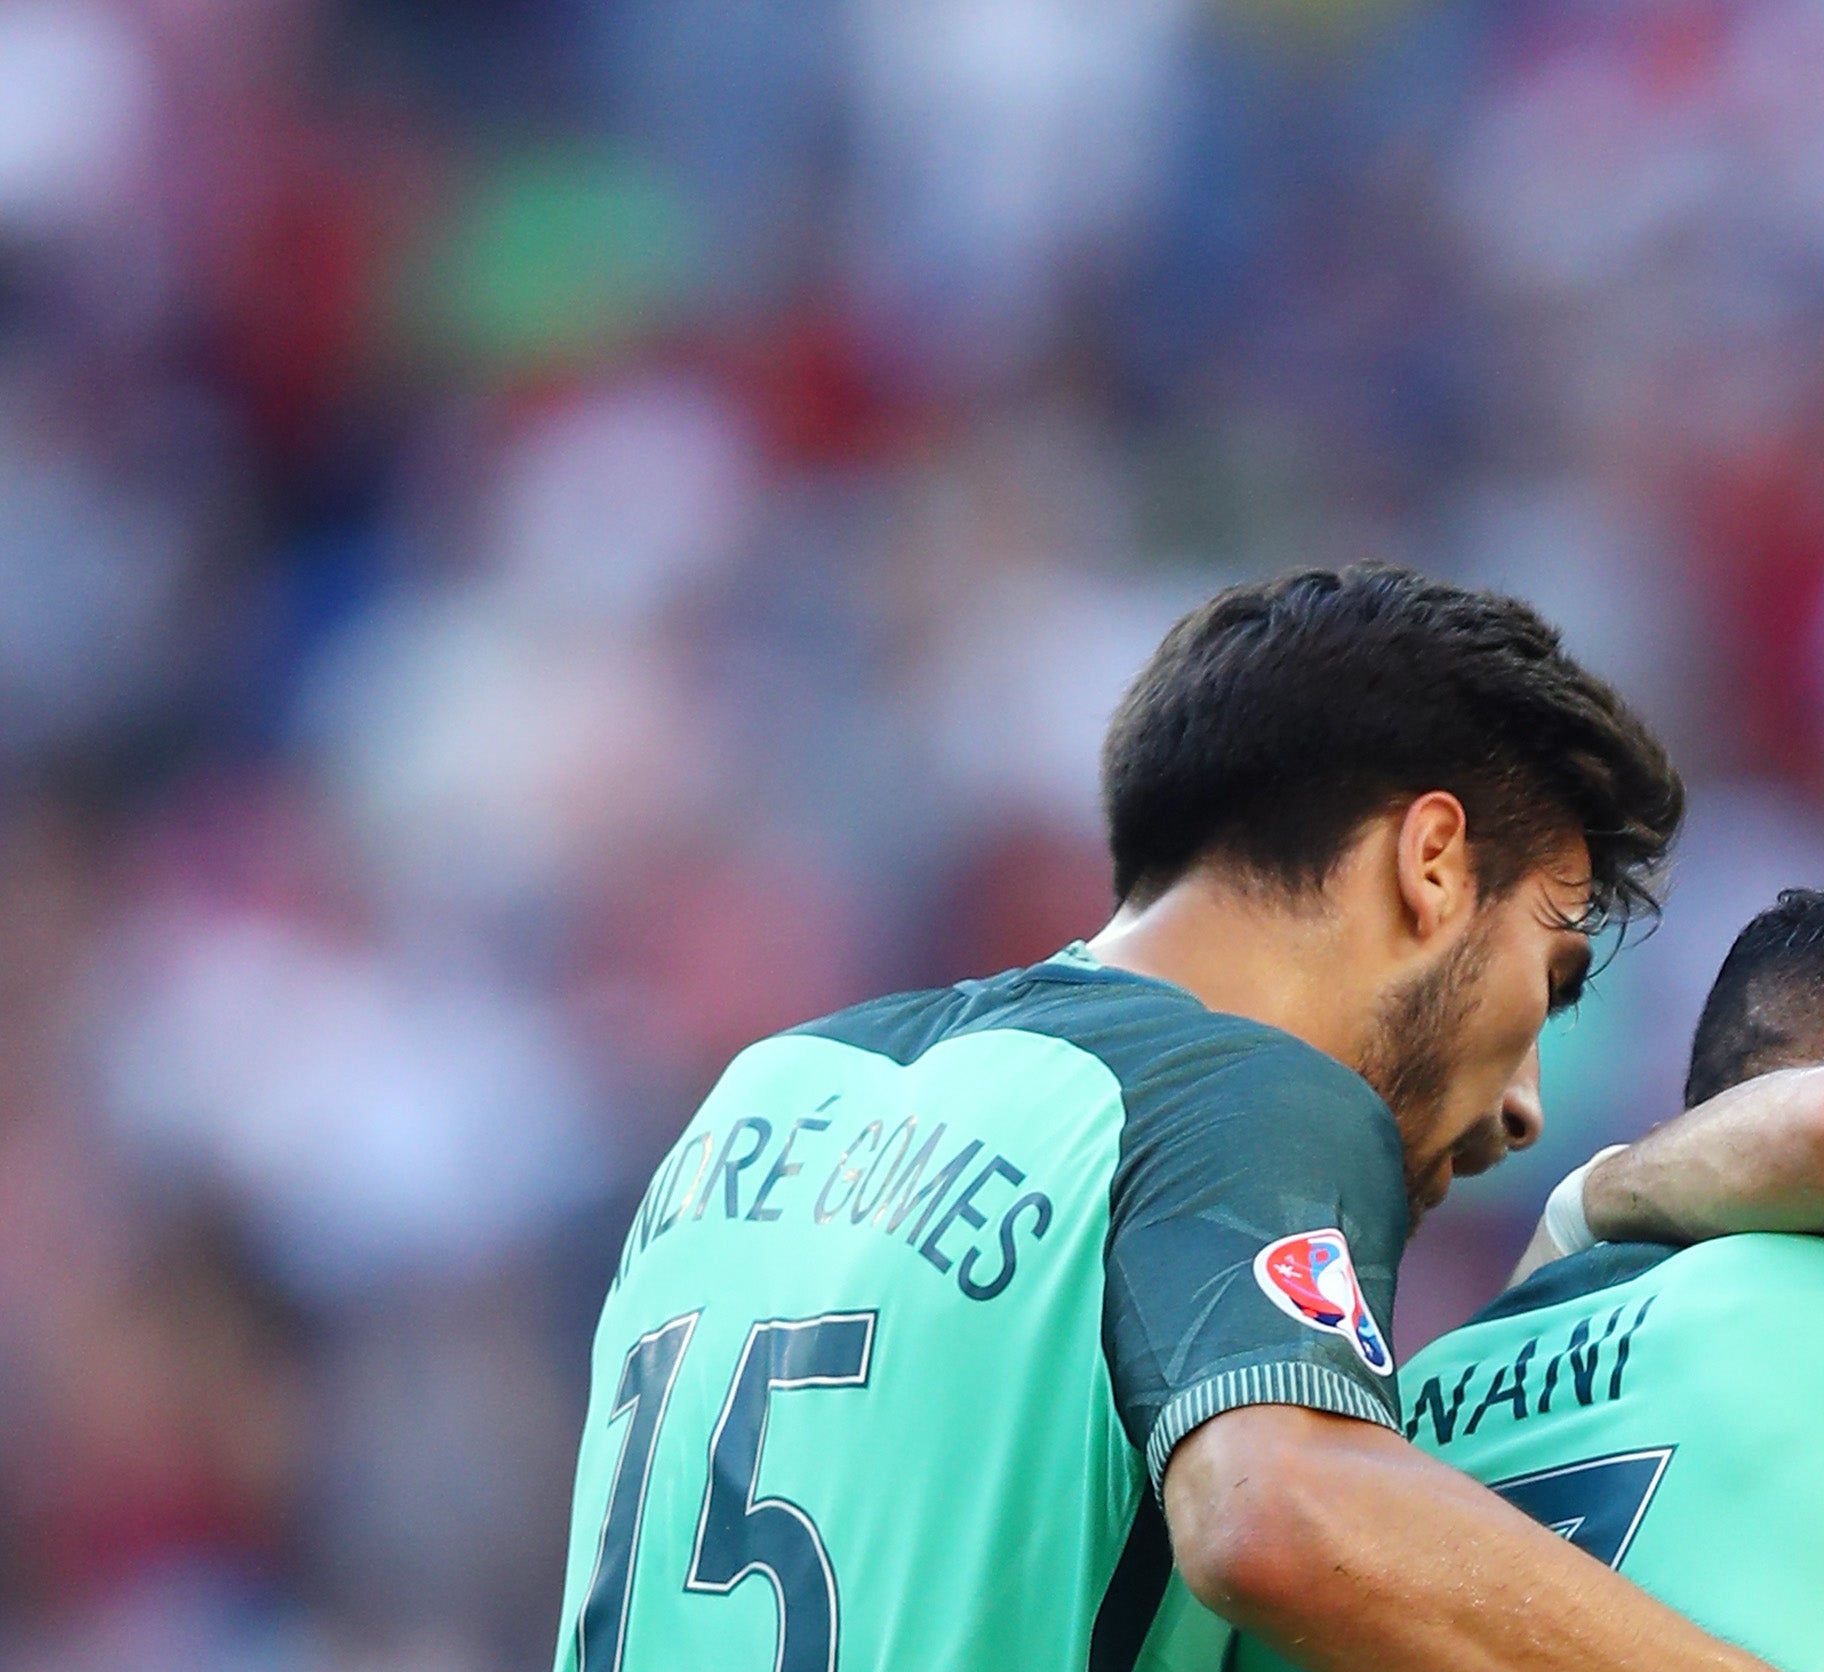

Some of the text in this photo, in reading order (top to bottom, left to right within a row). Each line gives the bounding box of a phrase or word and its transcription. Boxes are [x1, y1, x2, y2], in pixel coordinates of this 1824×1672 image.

[613, 1094, 1053, 1302] NDRÉ GOMES
[1405, 1294, 1657, 1446] NANI
